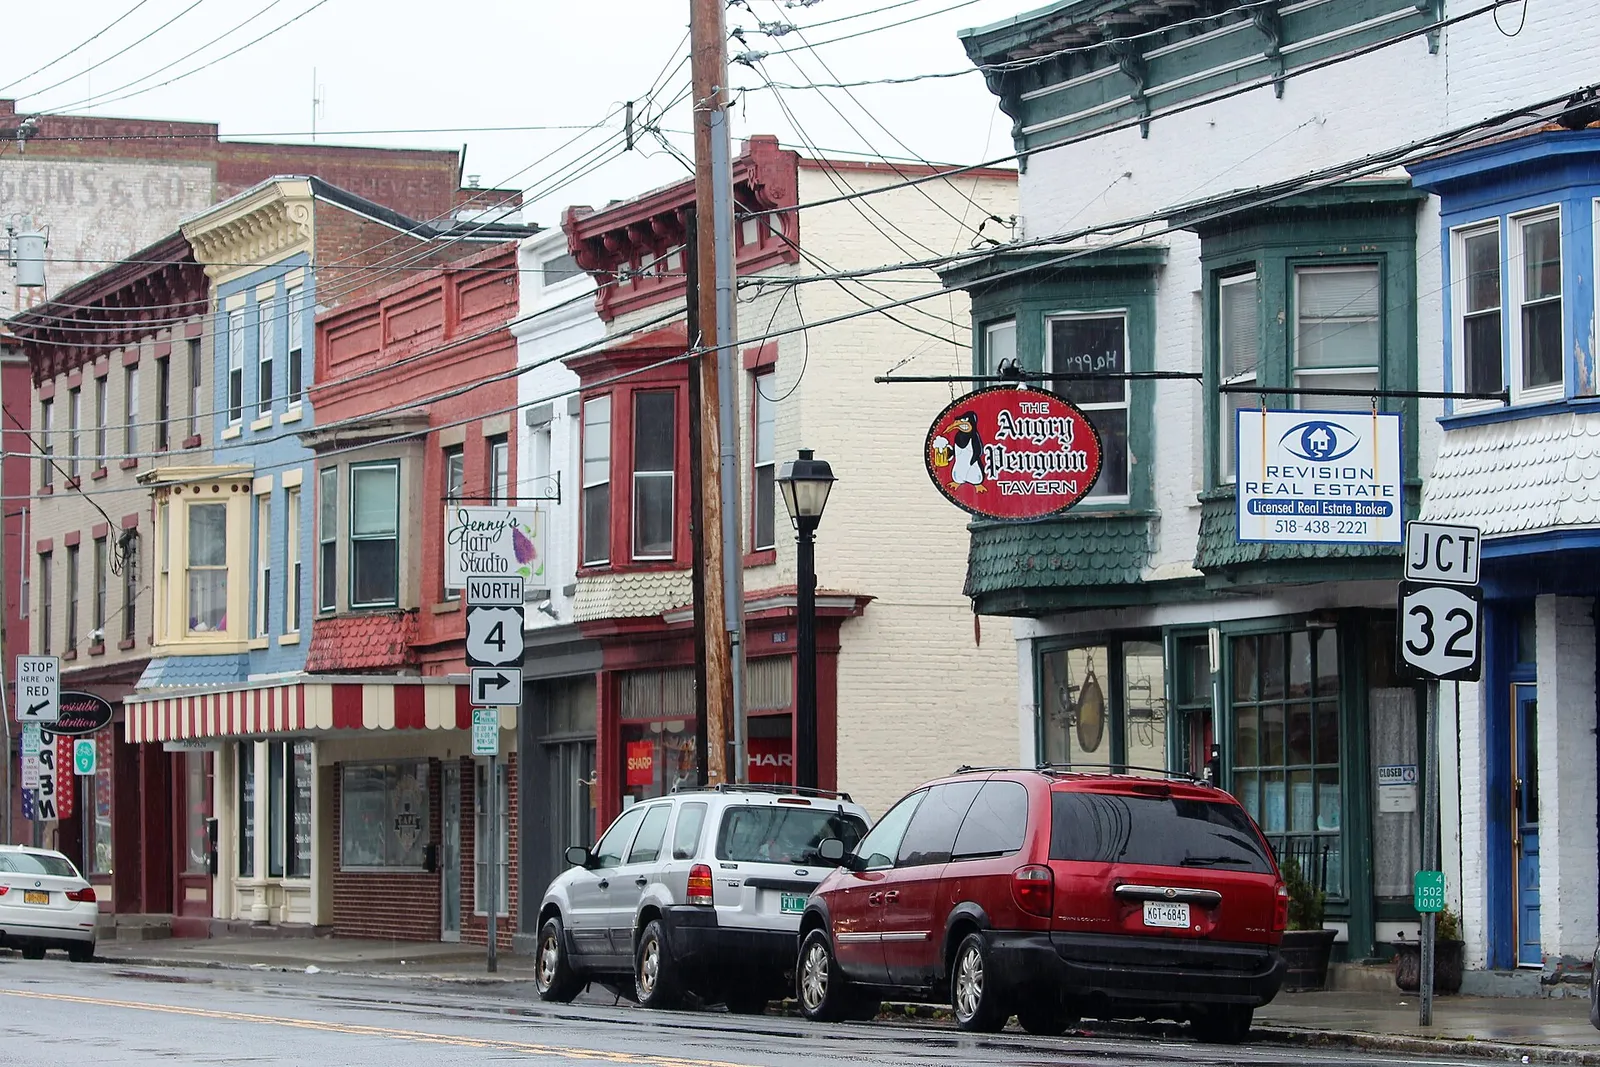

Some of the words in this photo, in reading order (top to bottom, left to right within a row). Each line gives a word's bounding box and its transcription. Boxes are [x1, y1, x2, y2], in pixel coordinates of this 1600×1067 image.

[1020, 402, 1049, 415] THE
[995, 409, 1074, 445] Angry
[984, 443, 1088, 480] Penguin
[1266, 466, 1374, 480] REVISION
[997, 480, 1077, 495] TAVERN
[1246, 482, 1304, 495] REAL
[1314, 484, 1394, 497] ESTATE
[1253, 500, 1294, 514] Licensed
[1298, 501, 1319, 514] Real
[1322, 502, 1352, 515] Estate
[1355, 502, 1387, 516] Broker
[448, 508, 520, 545] Jenny's
[1275, 520, 1367, 534] 518-438-2221
[460, 532, 492, 552] Hair
[1411, 533, 1475, 573] JCT
[460, 552, 508, 573] Studio
[471, 583, 520, 599] NORTH
[484, 621, 505, 652] 4
[1405, 605, 1474, 658] 32
[23, 662, 53, 673] STOP
[26, 686, 49, 696] RED
[58, 700, 99, 712] resistible
[474, 711, 480, 723] 2
[81, 758, 89, 769] 9
[627, 756, 652, 771] SHARP
[747, 754, 793, 767] HAR
[1379, 768, 1402, 777] CLOSED
[1436, 875, 1442, 884] 4
[1418, 887, 1442, 896] 1502
[1418, 898, 1442, 908] 1002
